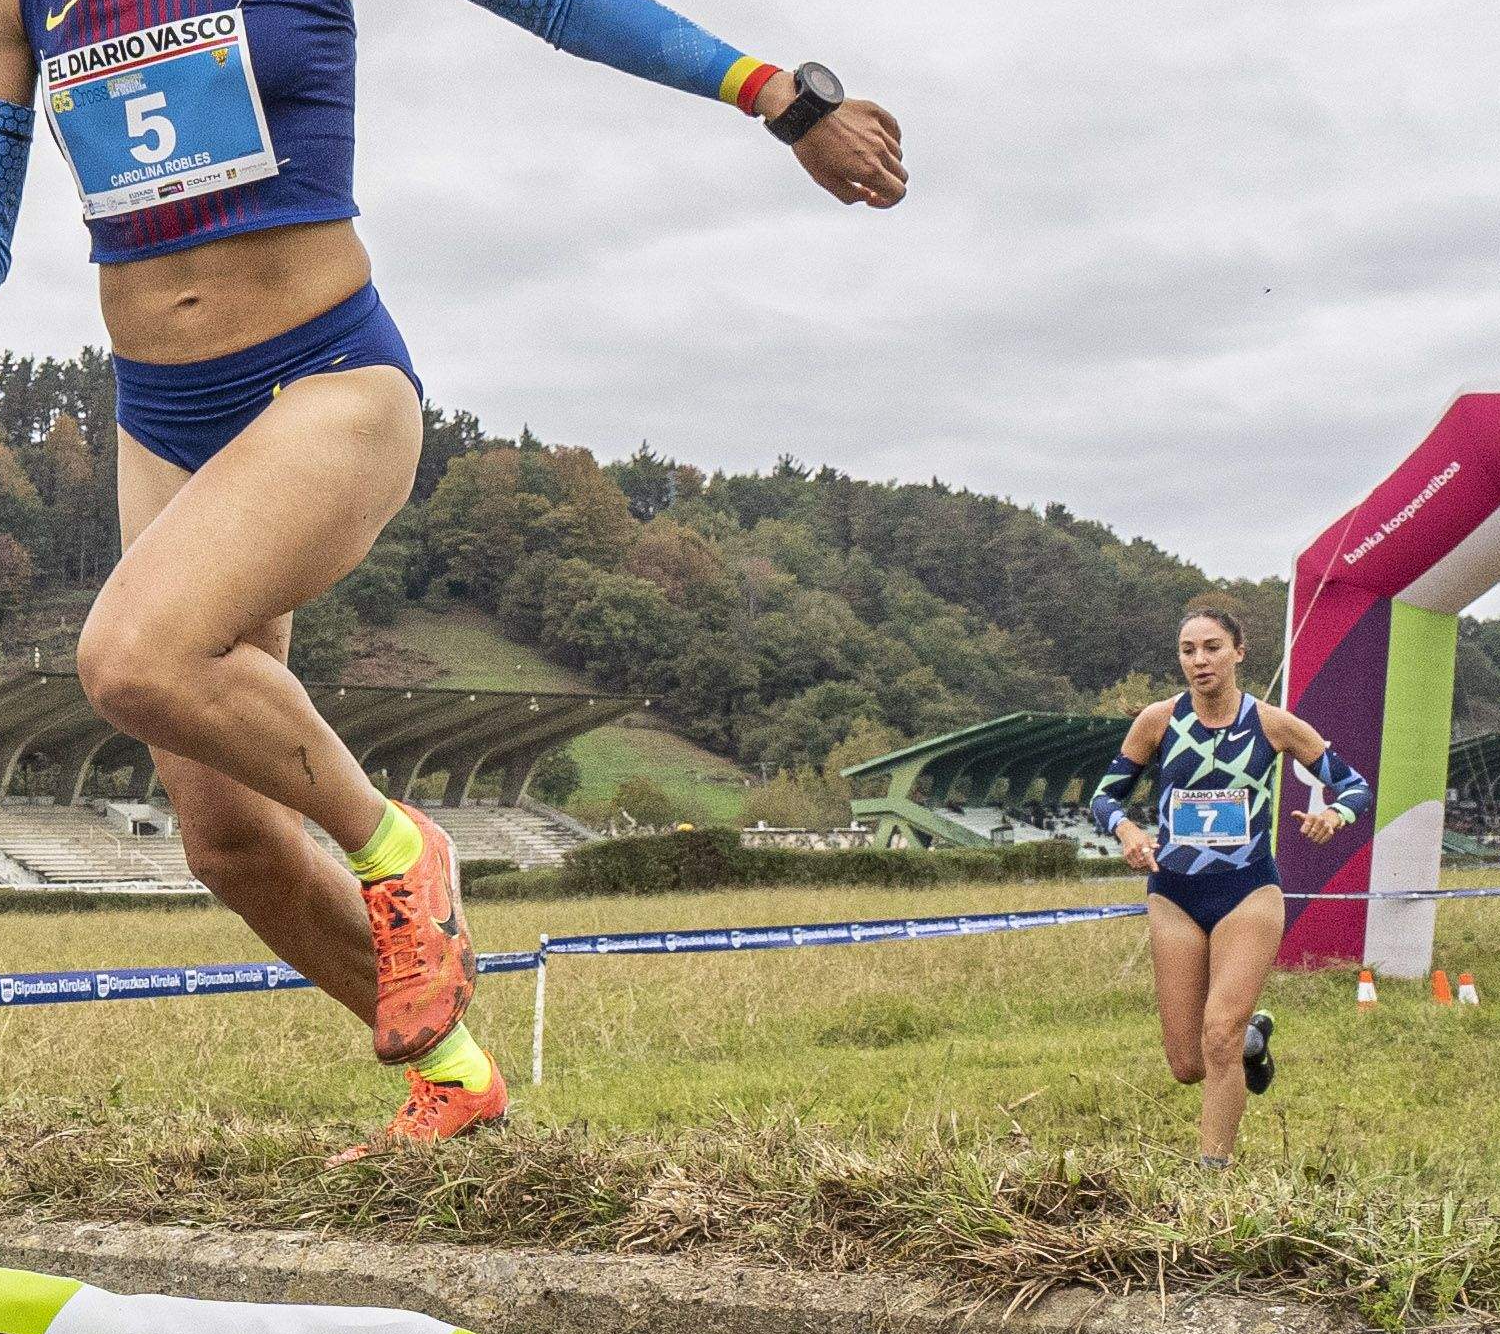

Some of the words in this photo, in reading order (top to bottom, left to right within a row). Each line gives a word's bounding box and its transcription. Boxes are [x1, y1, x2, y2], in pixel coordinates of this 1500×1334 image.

[46, 60, 67, 83] EL
[67, 36, 144, 78] DIARIO
[146, 14, 236, 51] VASCO
[124, 91, 177, 164] 5
[110, 163, 165, 187] CAROLINA
[164, 151, 212, 174] ROBLES
[1343, 531, 1385, 565] banka
[1380, 460, 1461, 535] kooperatiboa
[1197, 810, 1218, 832] 7
